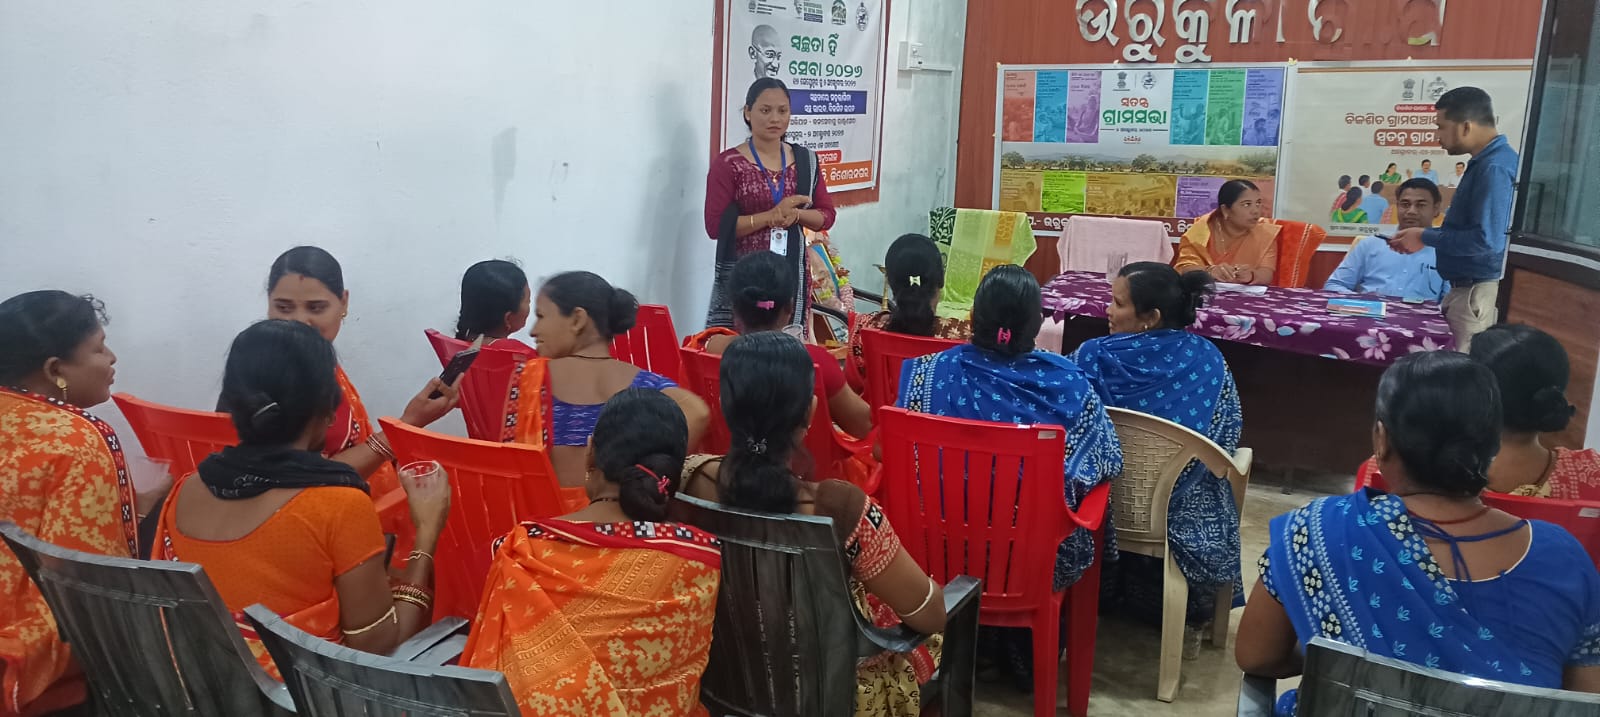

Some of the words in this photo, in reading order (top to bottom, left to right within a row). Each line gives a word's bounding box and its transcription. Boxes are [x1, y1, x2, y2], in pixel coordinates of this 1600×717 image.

[788, 60, 822, 77] ସେବା
[1102, 109, 1167, 126] ଗ୍ରାମସଭା
[1387, 114, 1438, 128] ଗ୍ରାମପଞ୍ଚା
